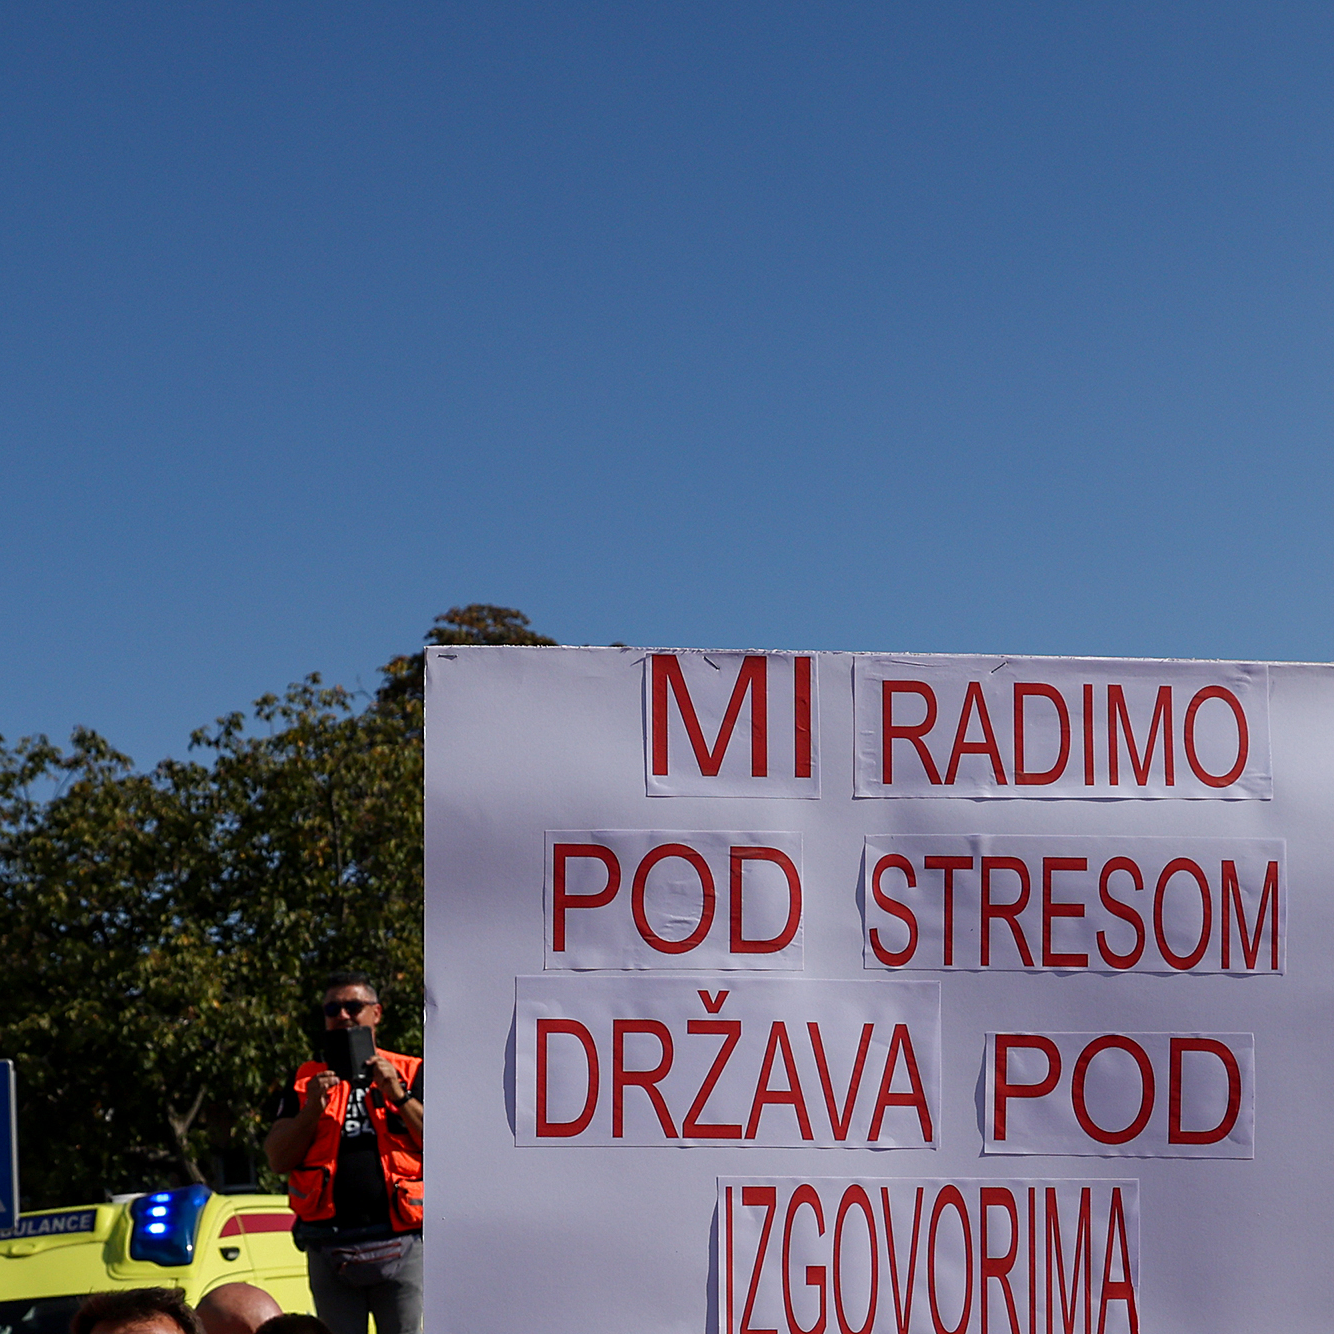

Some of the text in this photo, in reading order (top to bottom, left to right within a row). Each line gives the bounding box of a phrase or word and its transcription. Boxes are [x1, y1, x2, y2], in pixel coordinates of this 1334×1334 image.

[653, 655, 1248, 787] MI RADIMO
[554, 844, 1278, 969] POD STRESOM
[537, 991, 1240, 1144] DRŽAVA POD
